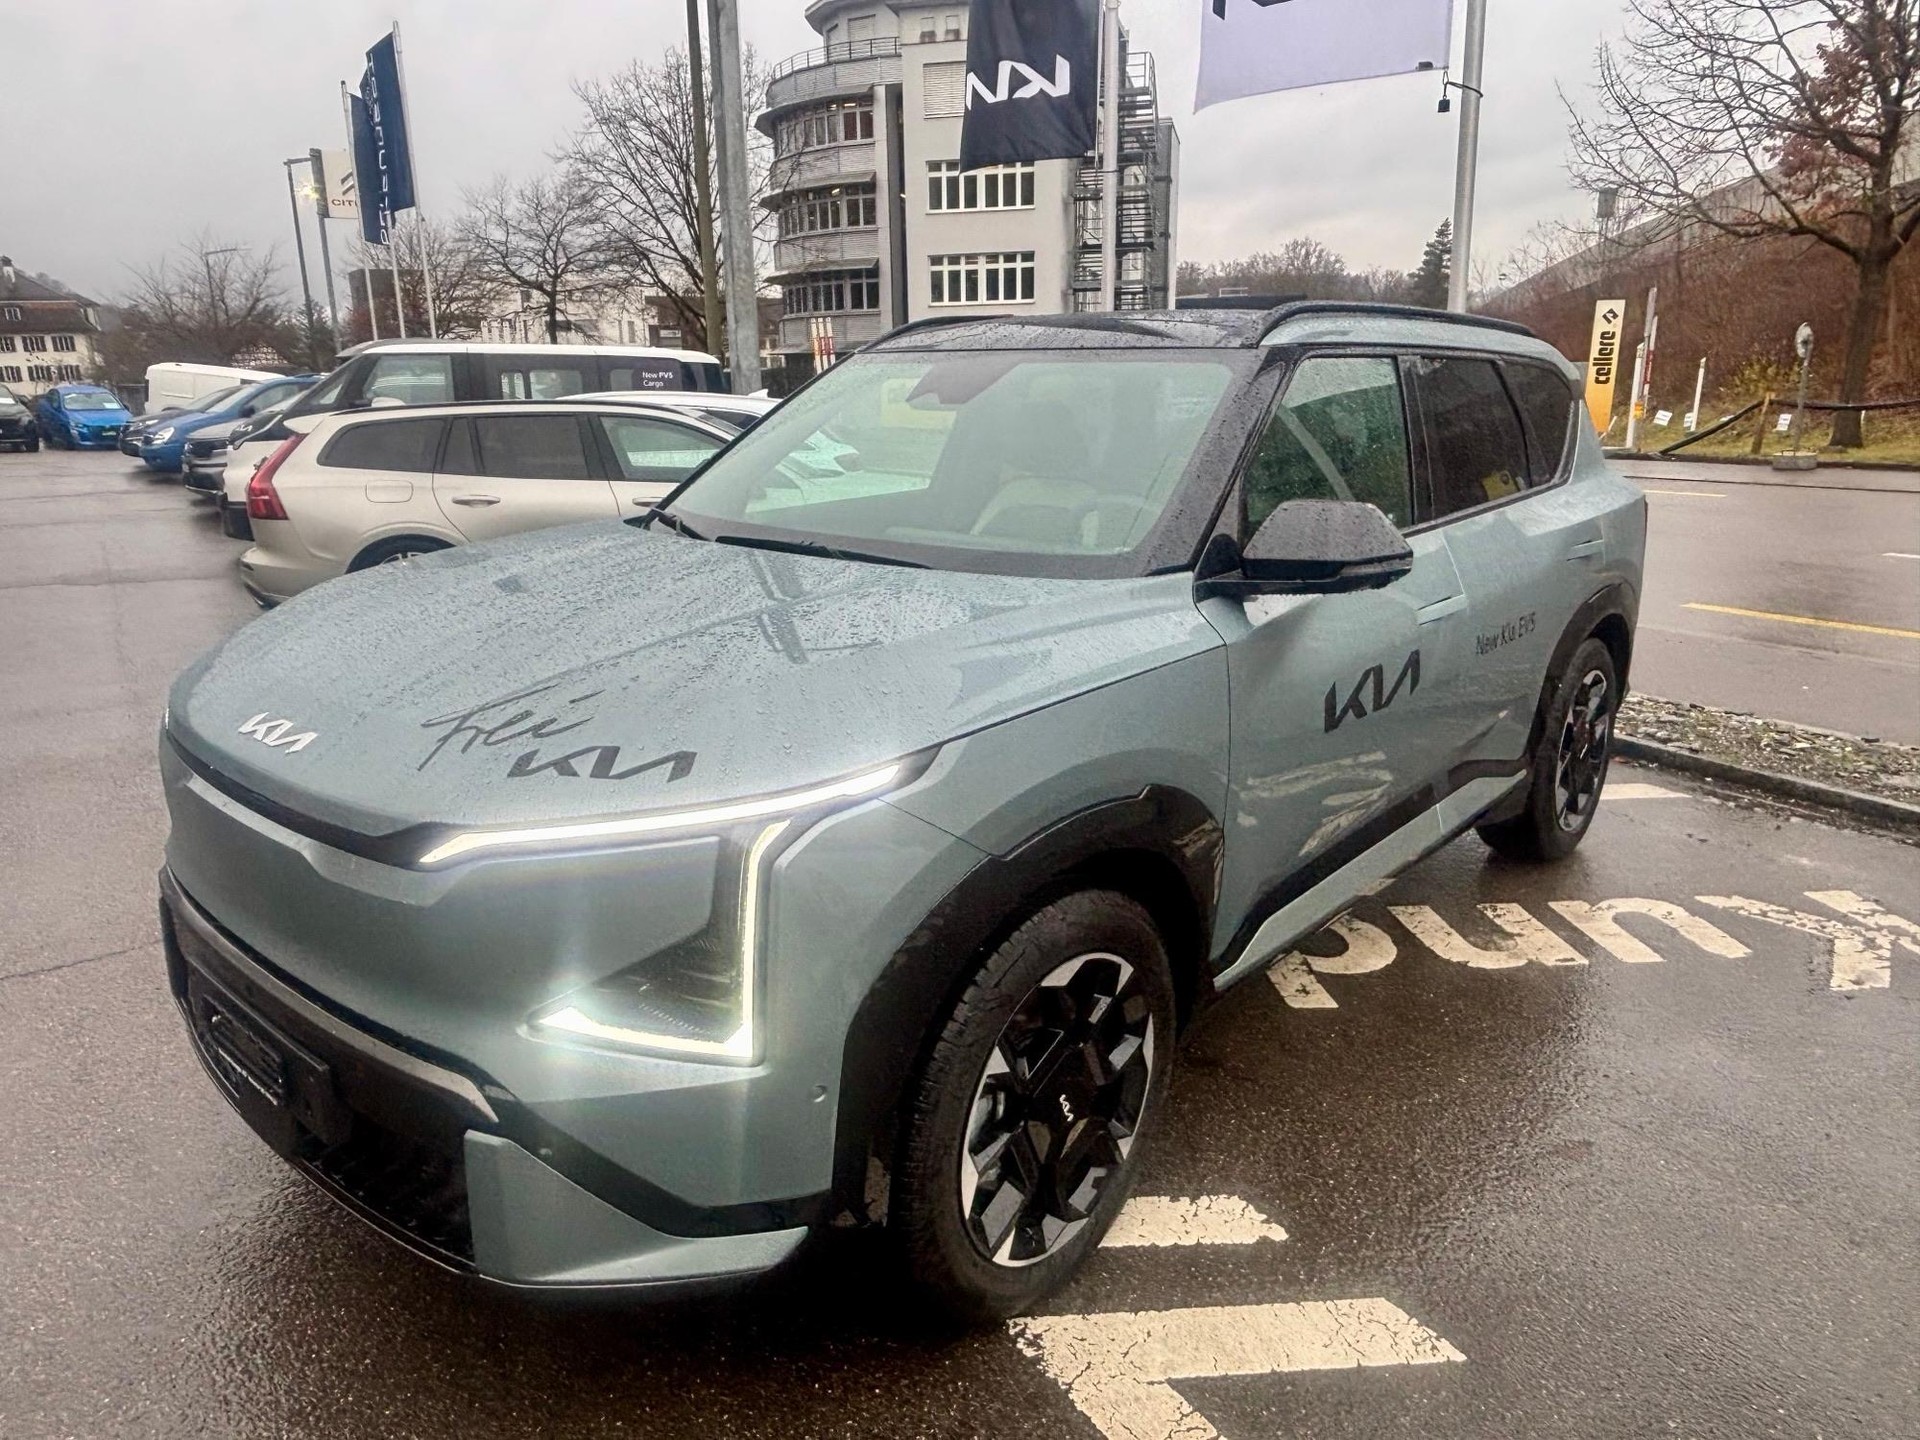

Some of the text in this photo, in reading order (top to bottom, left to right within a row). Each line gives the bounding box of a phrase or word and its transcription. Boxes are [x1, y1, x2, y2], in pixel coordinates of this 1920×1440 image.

[642, 371, 658, 379] New
[1592, 330, 1616, 385] cellere
[643, 380, 664, 388] Cargo
[1324, 649, 1421, 733] KIA
[237, 711, 319, 754] KIA
[507, 745, 698, 784] KIA
[1266, 888, 1920, 1010] Kund
